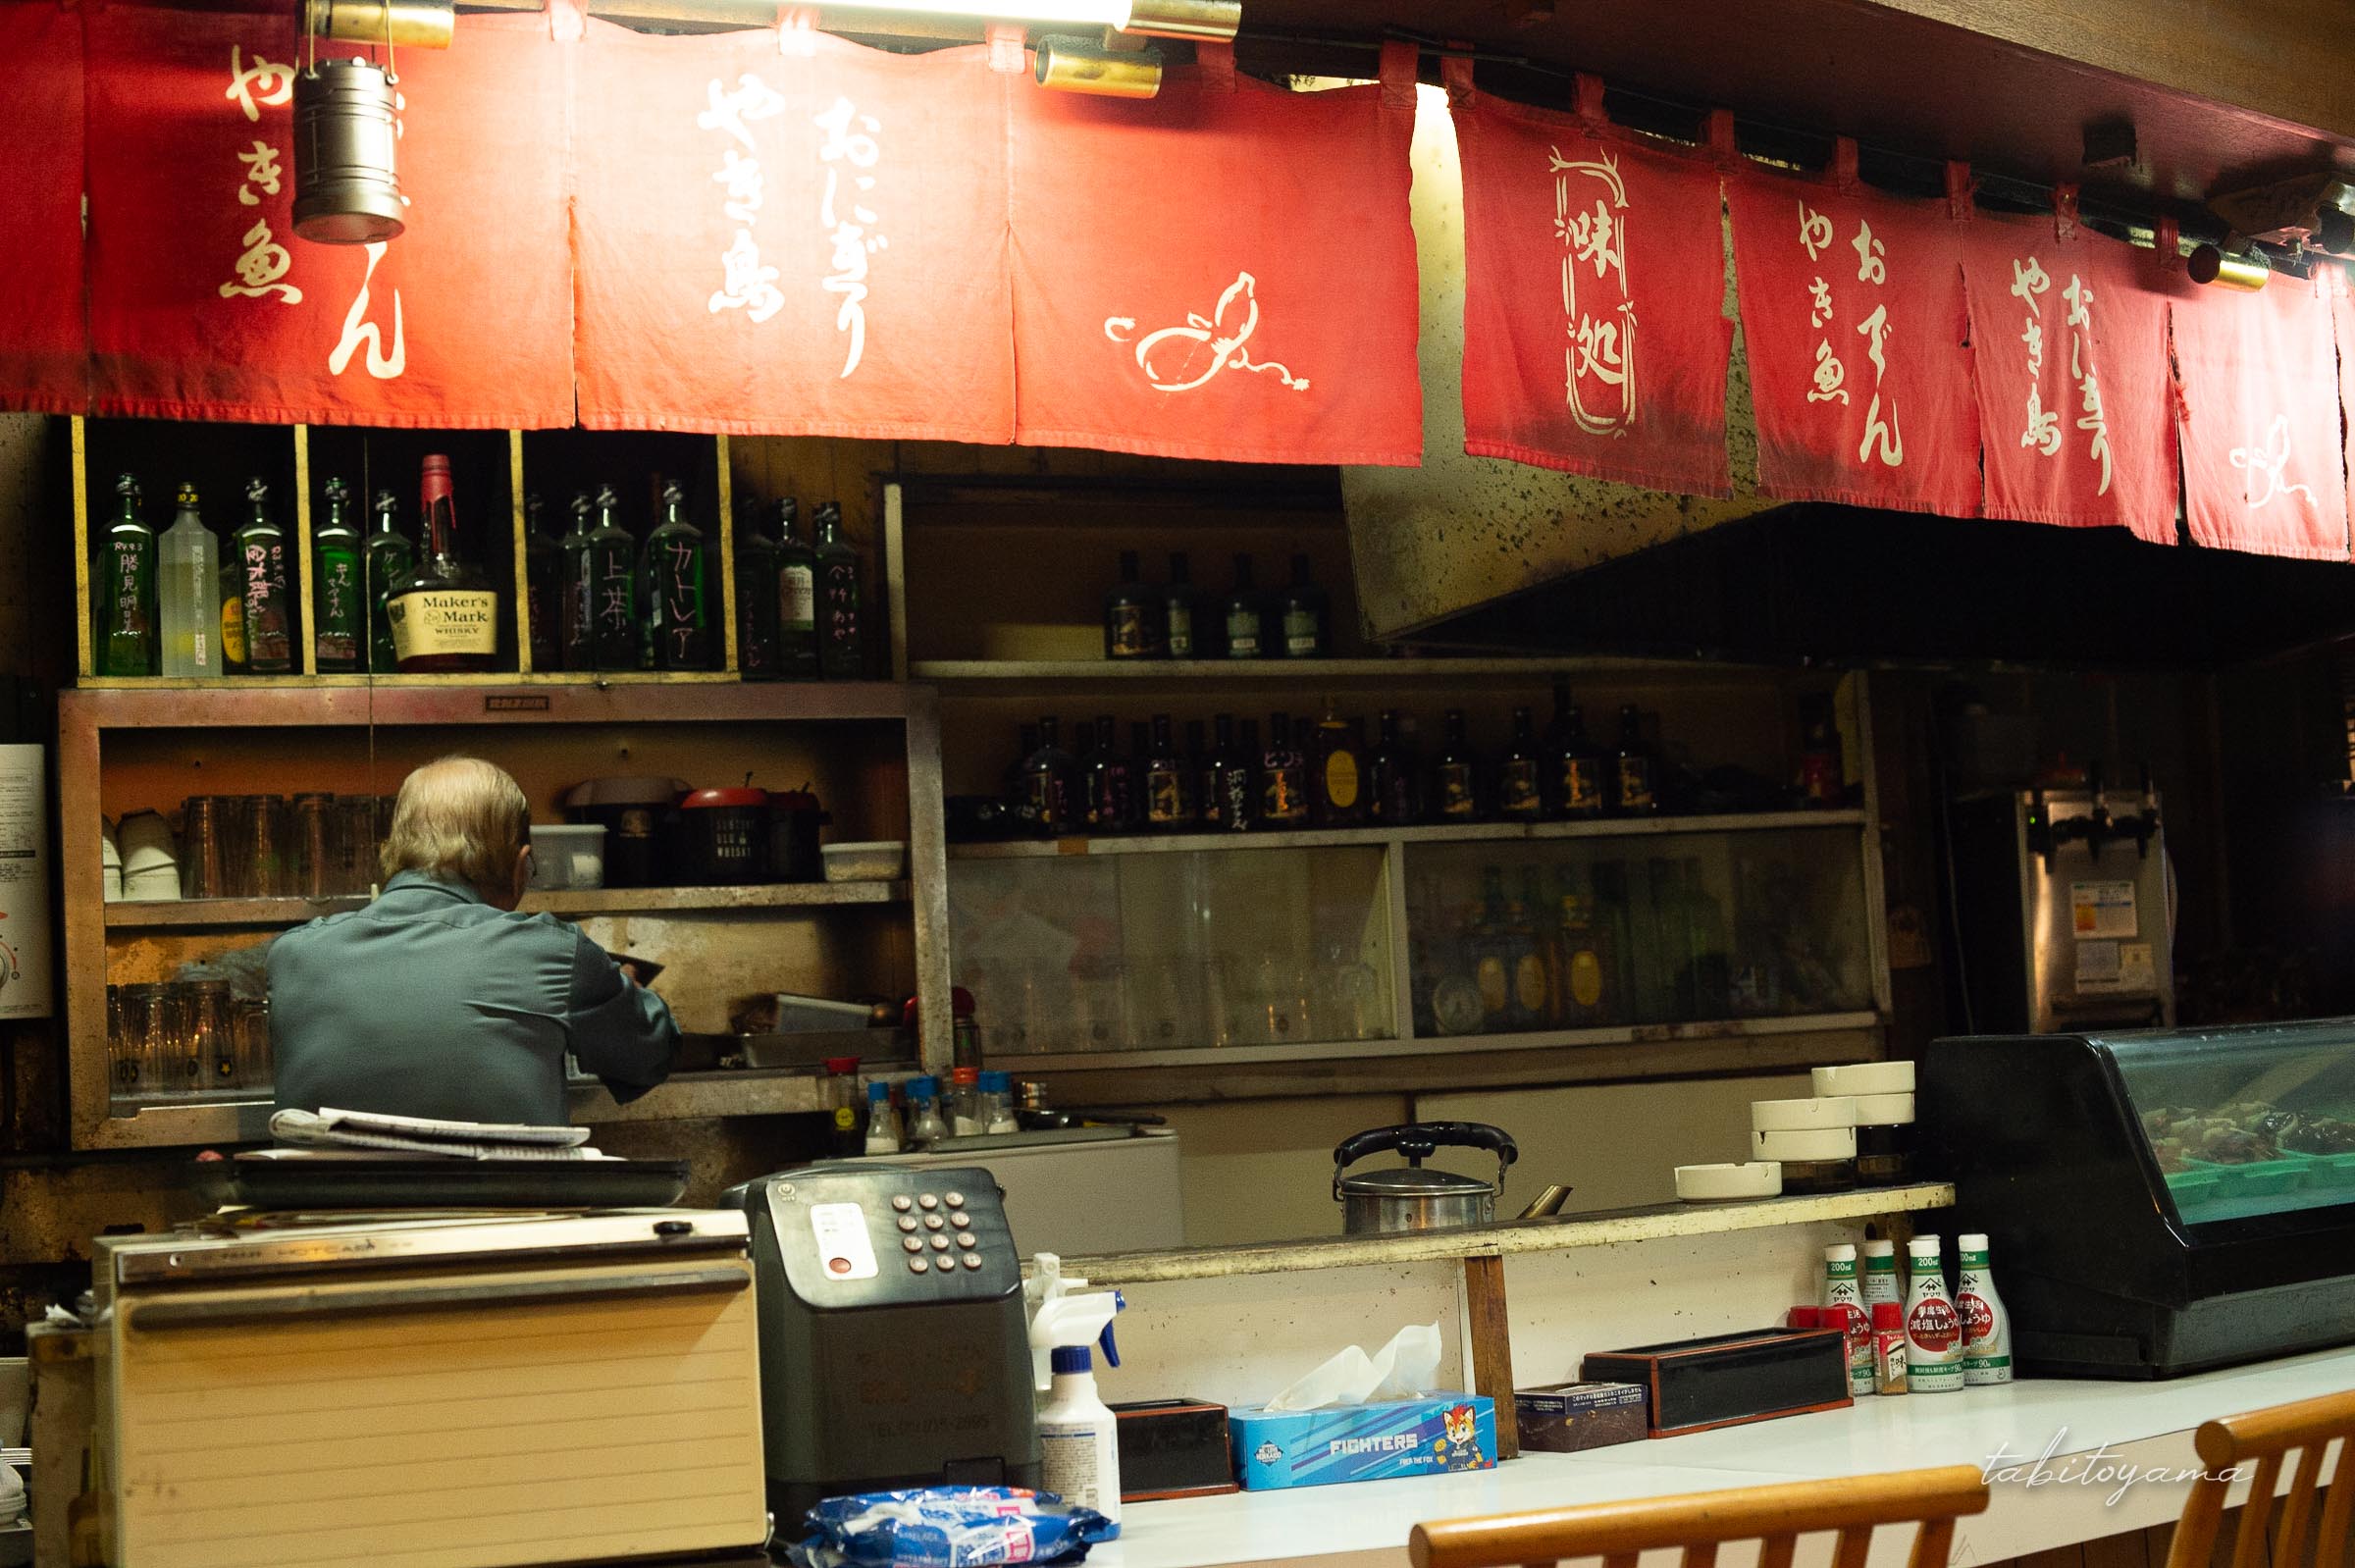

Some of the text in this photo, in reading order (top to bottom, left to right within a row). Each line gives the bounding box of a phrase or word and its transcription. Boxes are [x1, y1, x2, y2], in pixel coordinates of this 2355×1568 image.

[219, 44, 302, 305] やき魚
[698, 74, 786, 323] やき鳥
[813, 97, 888, 380] おにぎり
[1569, 199, 1624, 385] 味処
[1799, 198, 1849, 406] やき魚
[1852, 219, 1904, 468] おでん
[2011, 255, 2063, 456] やき鳥
[2063, 274, 2112, 497] おにぎり
[423, 597, 489, 608] Maker's
[435, 627, 480, 636] WHISKY
[444, 610, 489, 623] Mark
[666, 541, 696, 659] カトレア
[1851, 1322, 1871, 1334] ょうゆ
[1960, 1313, 1991, 1326] しょうゆ
[1330, 1433, 1418, 1455] FIGHTERS
